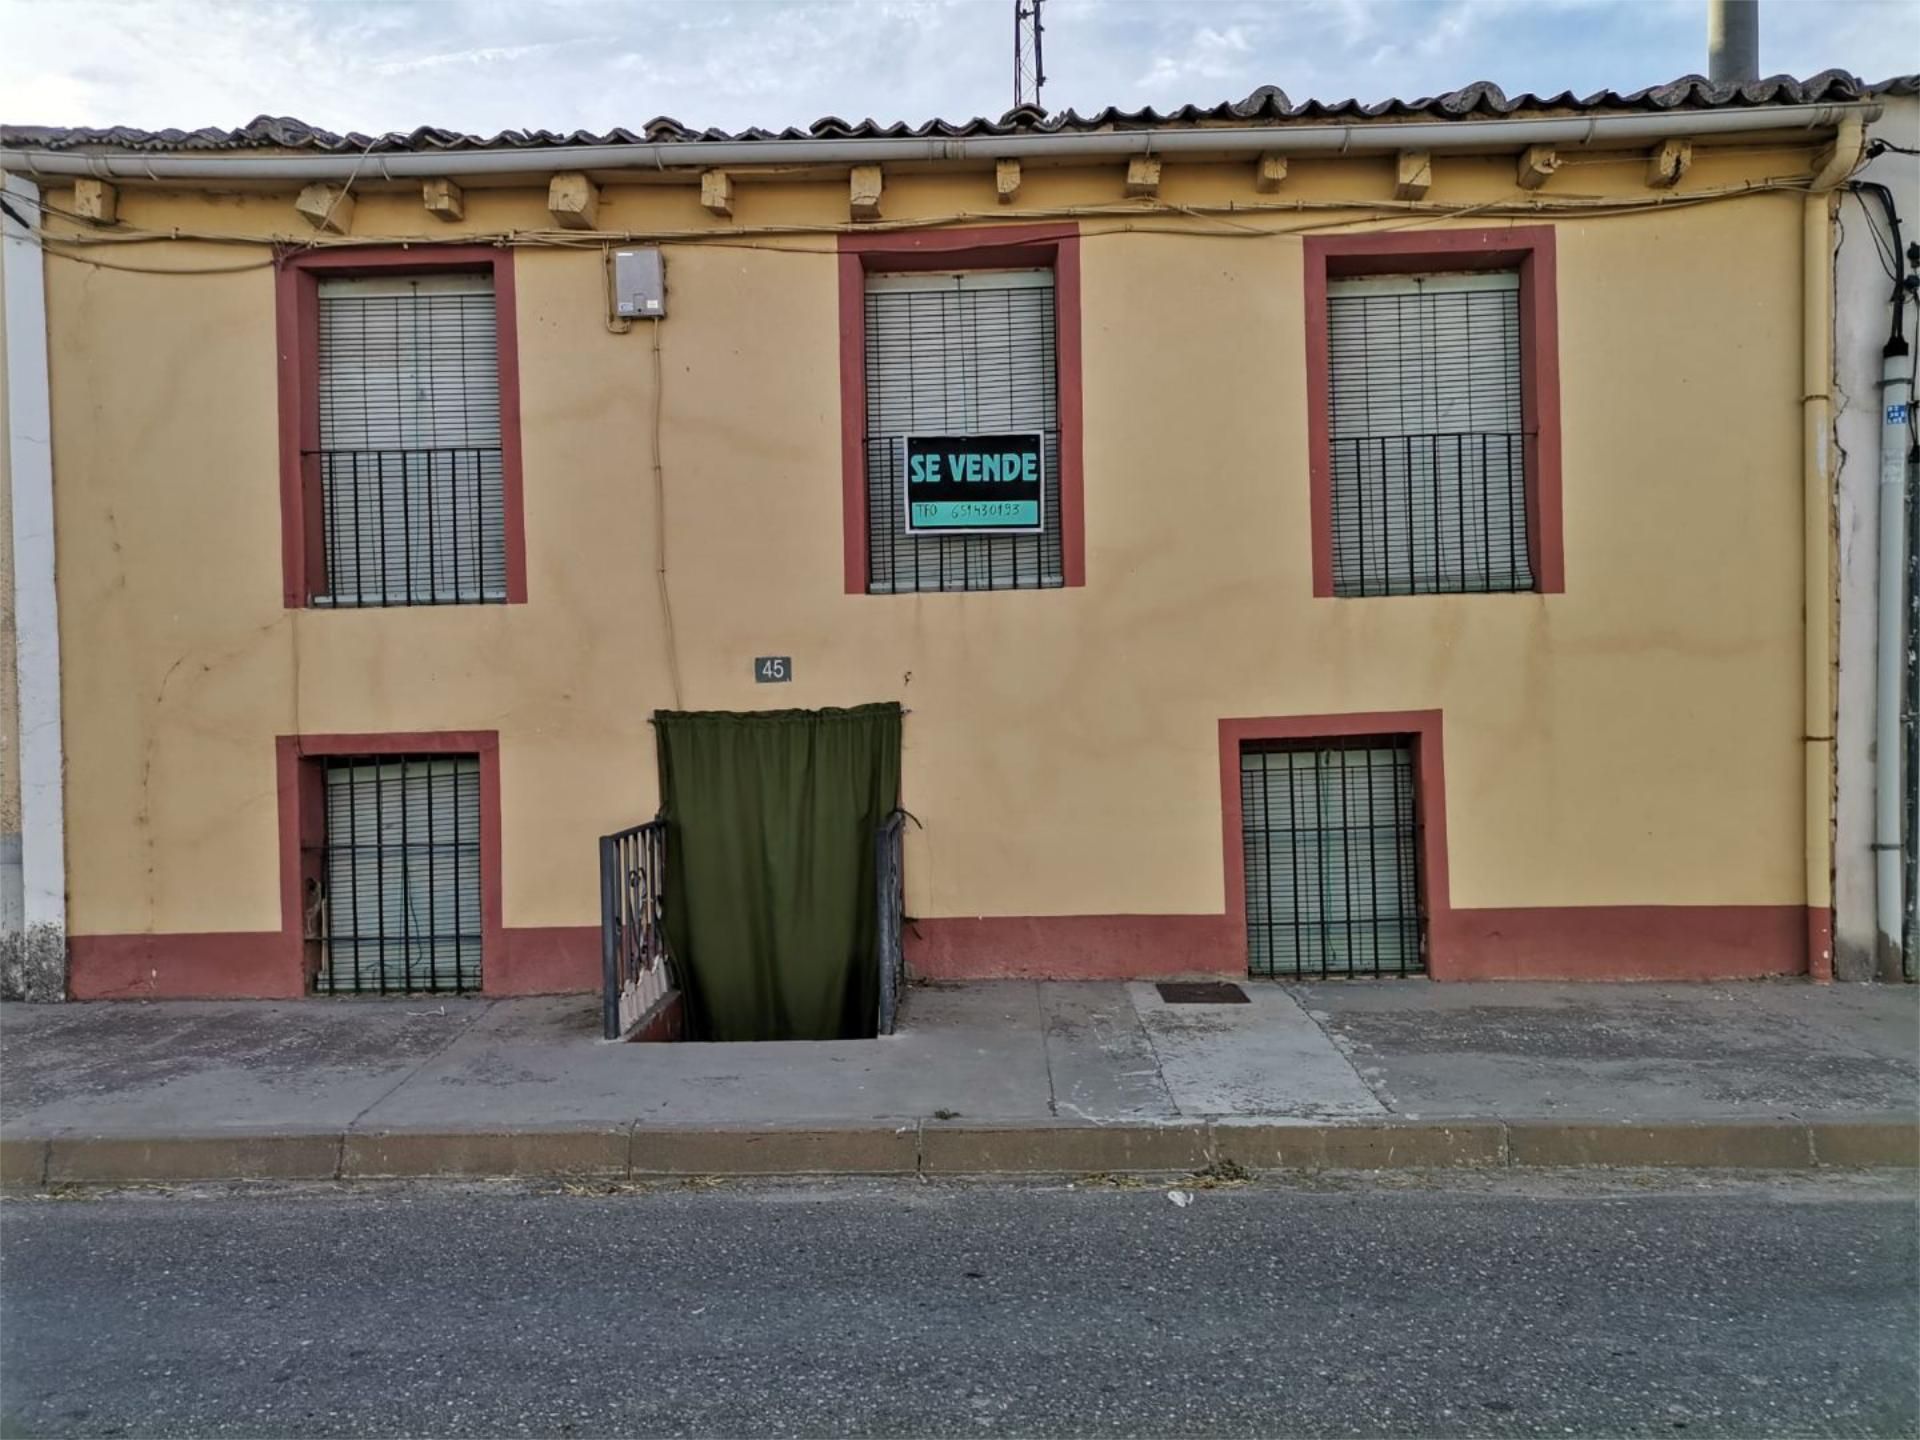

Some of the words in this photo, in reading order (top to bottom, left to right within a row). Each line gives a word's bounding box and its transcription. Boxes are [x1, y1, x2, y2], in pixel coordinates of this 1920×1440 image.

[910, 454, 941, 482] SE
[948, 452, 1037, 482] VENDE
[762, 659, 784, 678] 45
